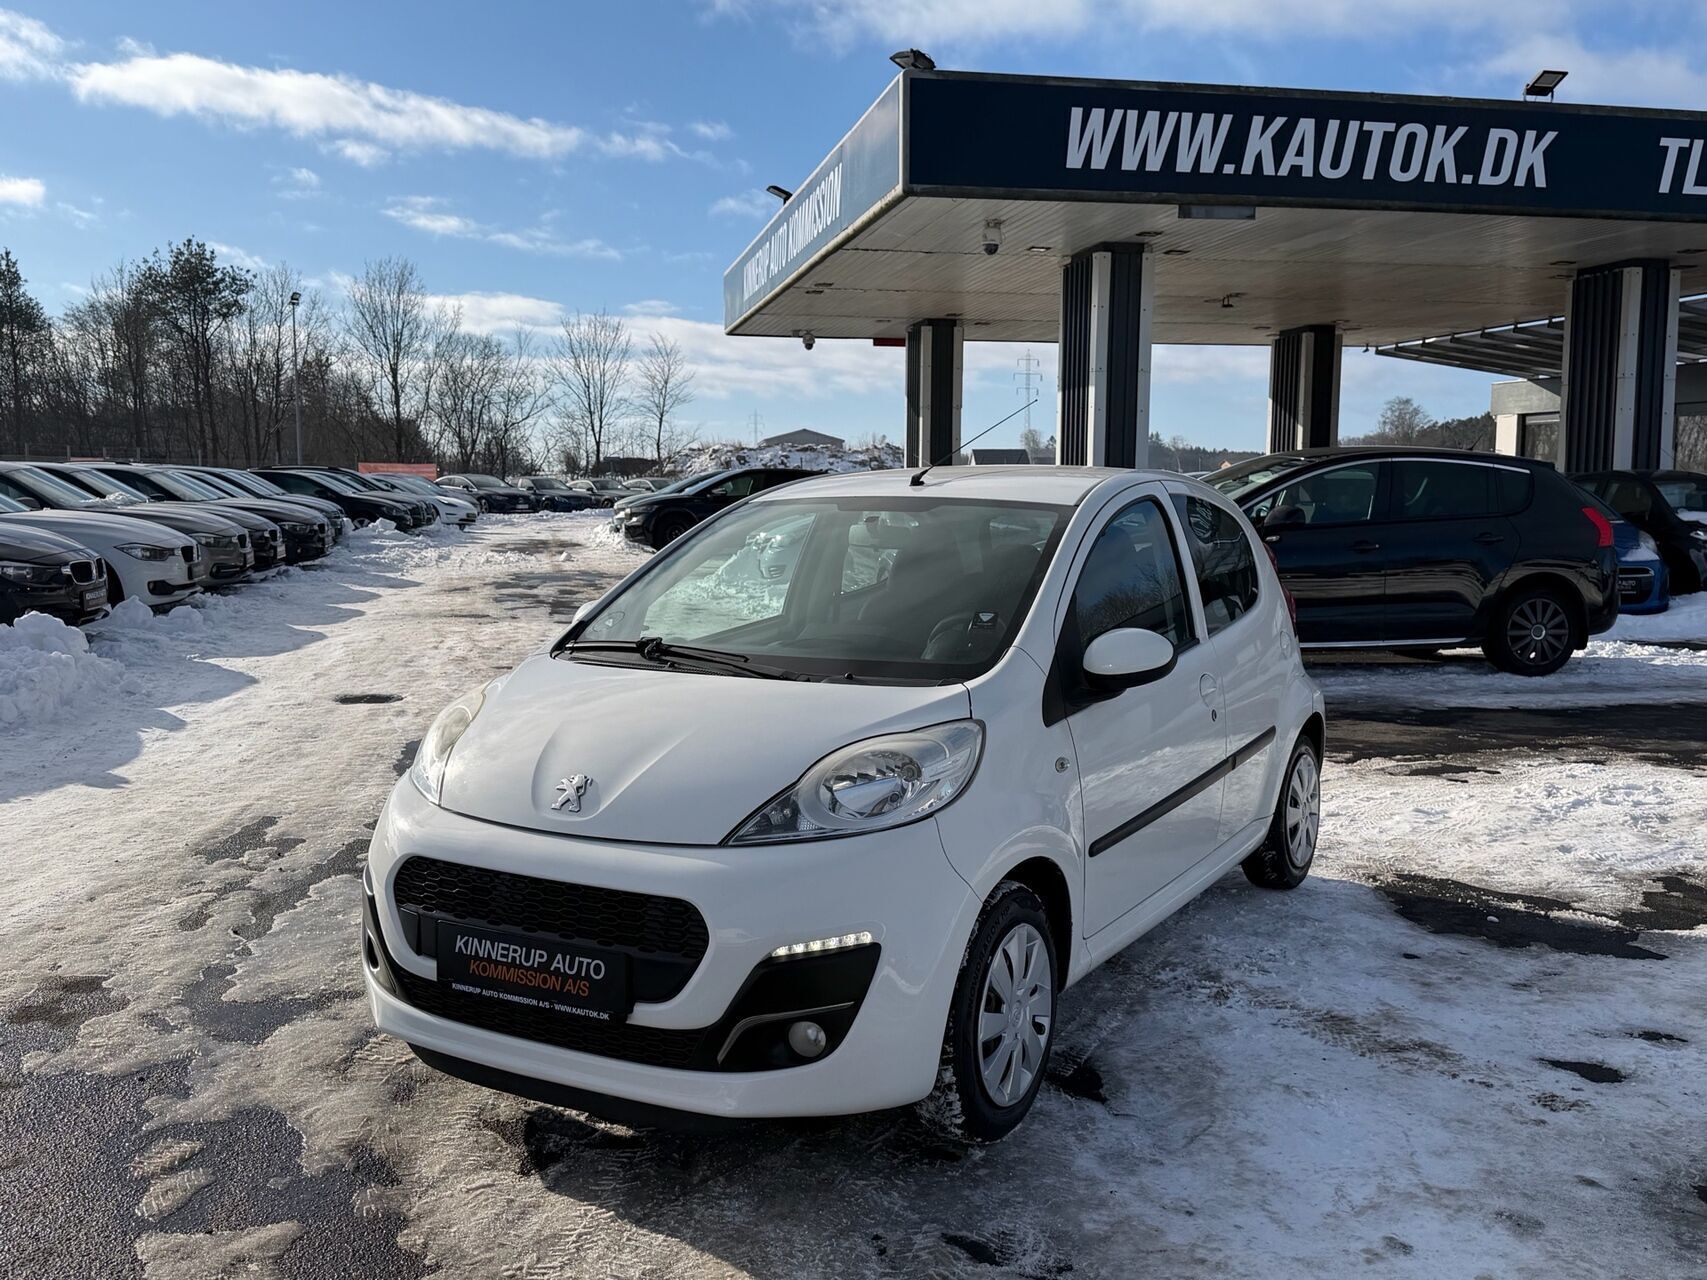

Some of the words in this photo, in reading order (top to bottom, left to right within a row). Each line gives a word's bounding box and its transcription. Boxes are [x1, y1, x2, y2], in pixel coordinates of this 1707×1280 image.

[1065, 106, 1558, 189] WWW.KAUTOK.DK
[769, 221, 788, 279] AUTO
[787, 162, 842, 262] KOMMISSION
[455, 934, 548, 968] KINNERUP
[550, 953, 606, 980] AUTO
[469, 959, 562, 992] KOMMISSION
[564, 978, 590, 997] A/S
[452, 982, 482, 995] KINNERUP
[482, 989, 499, 998] AUTO
[499, 991, 538, 1007] KOMMISSION
[539, 998, 550, 1009] A/S
[554, 1003, 610, 1021] WWW.KAUTOK.DK
